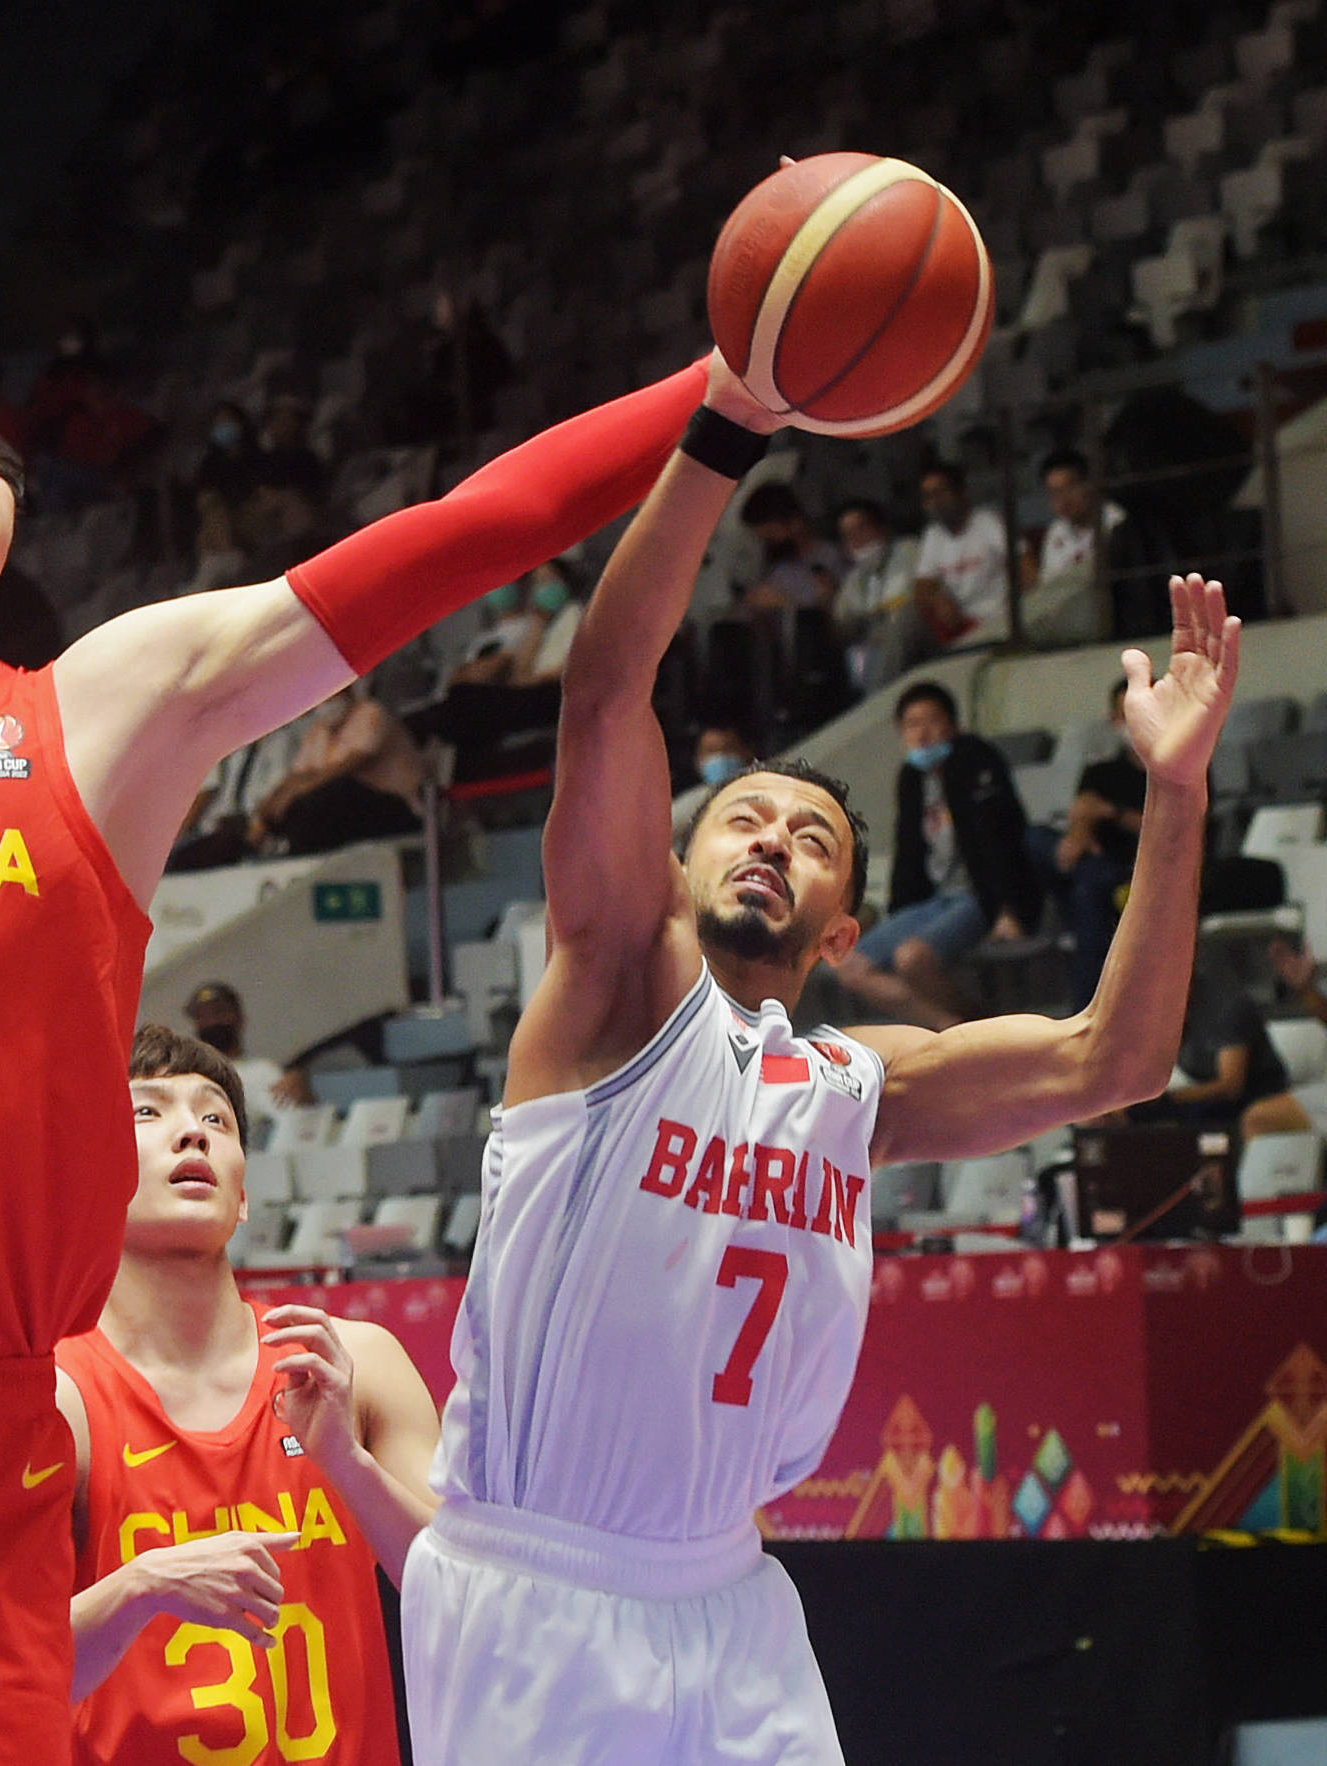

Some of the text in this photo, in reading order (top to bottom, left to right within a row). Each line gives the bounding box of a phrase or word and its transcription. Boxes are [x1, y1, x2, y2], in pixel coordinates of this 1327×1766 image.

[3, 758, 28, 772] CUP
[712, 1245, 789, 1407] 7
[165, 1603, 338, 1766] 30
